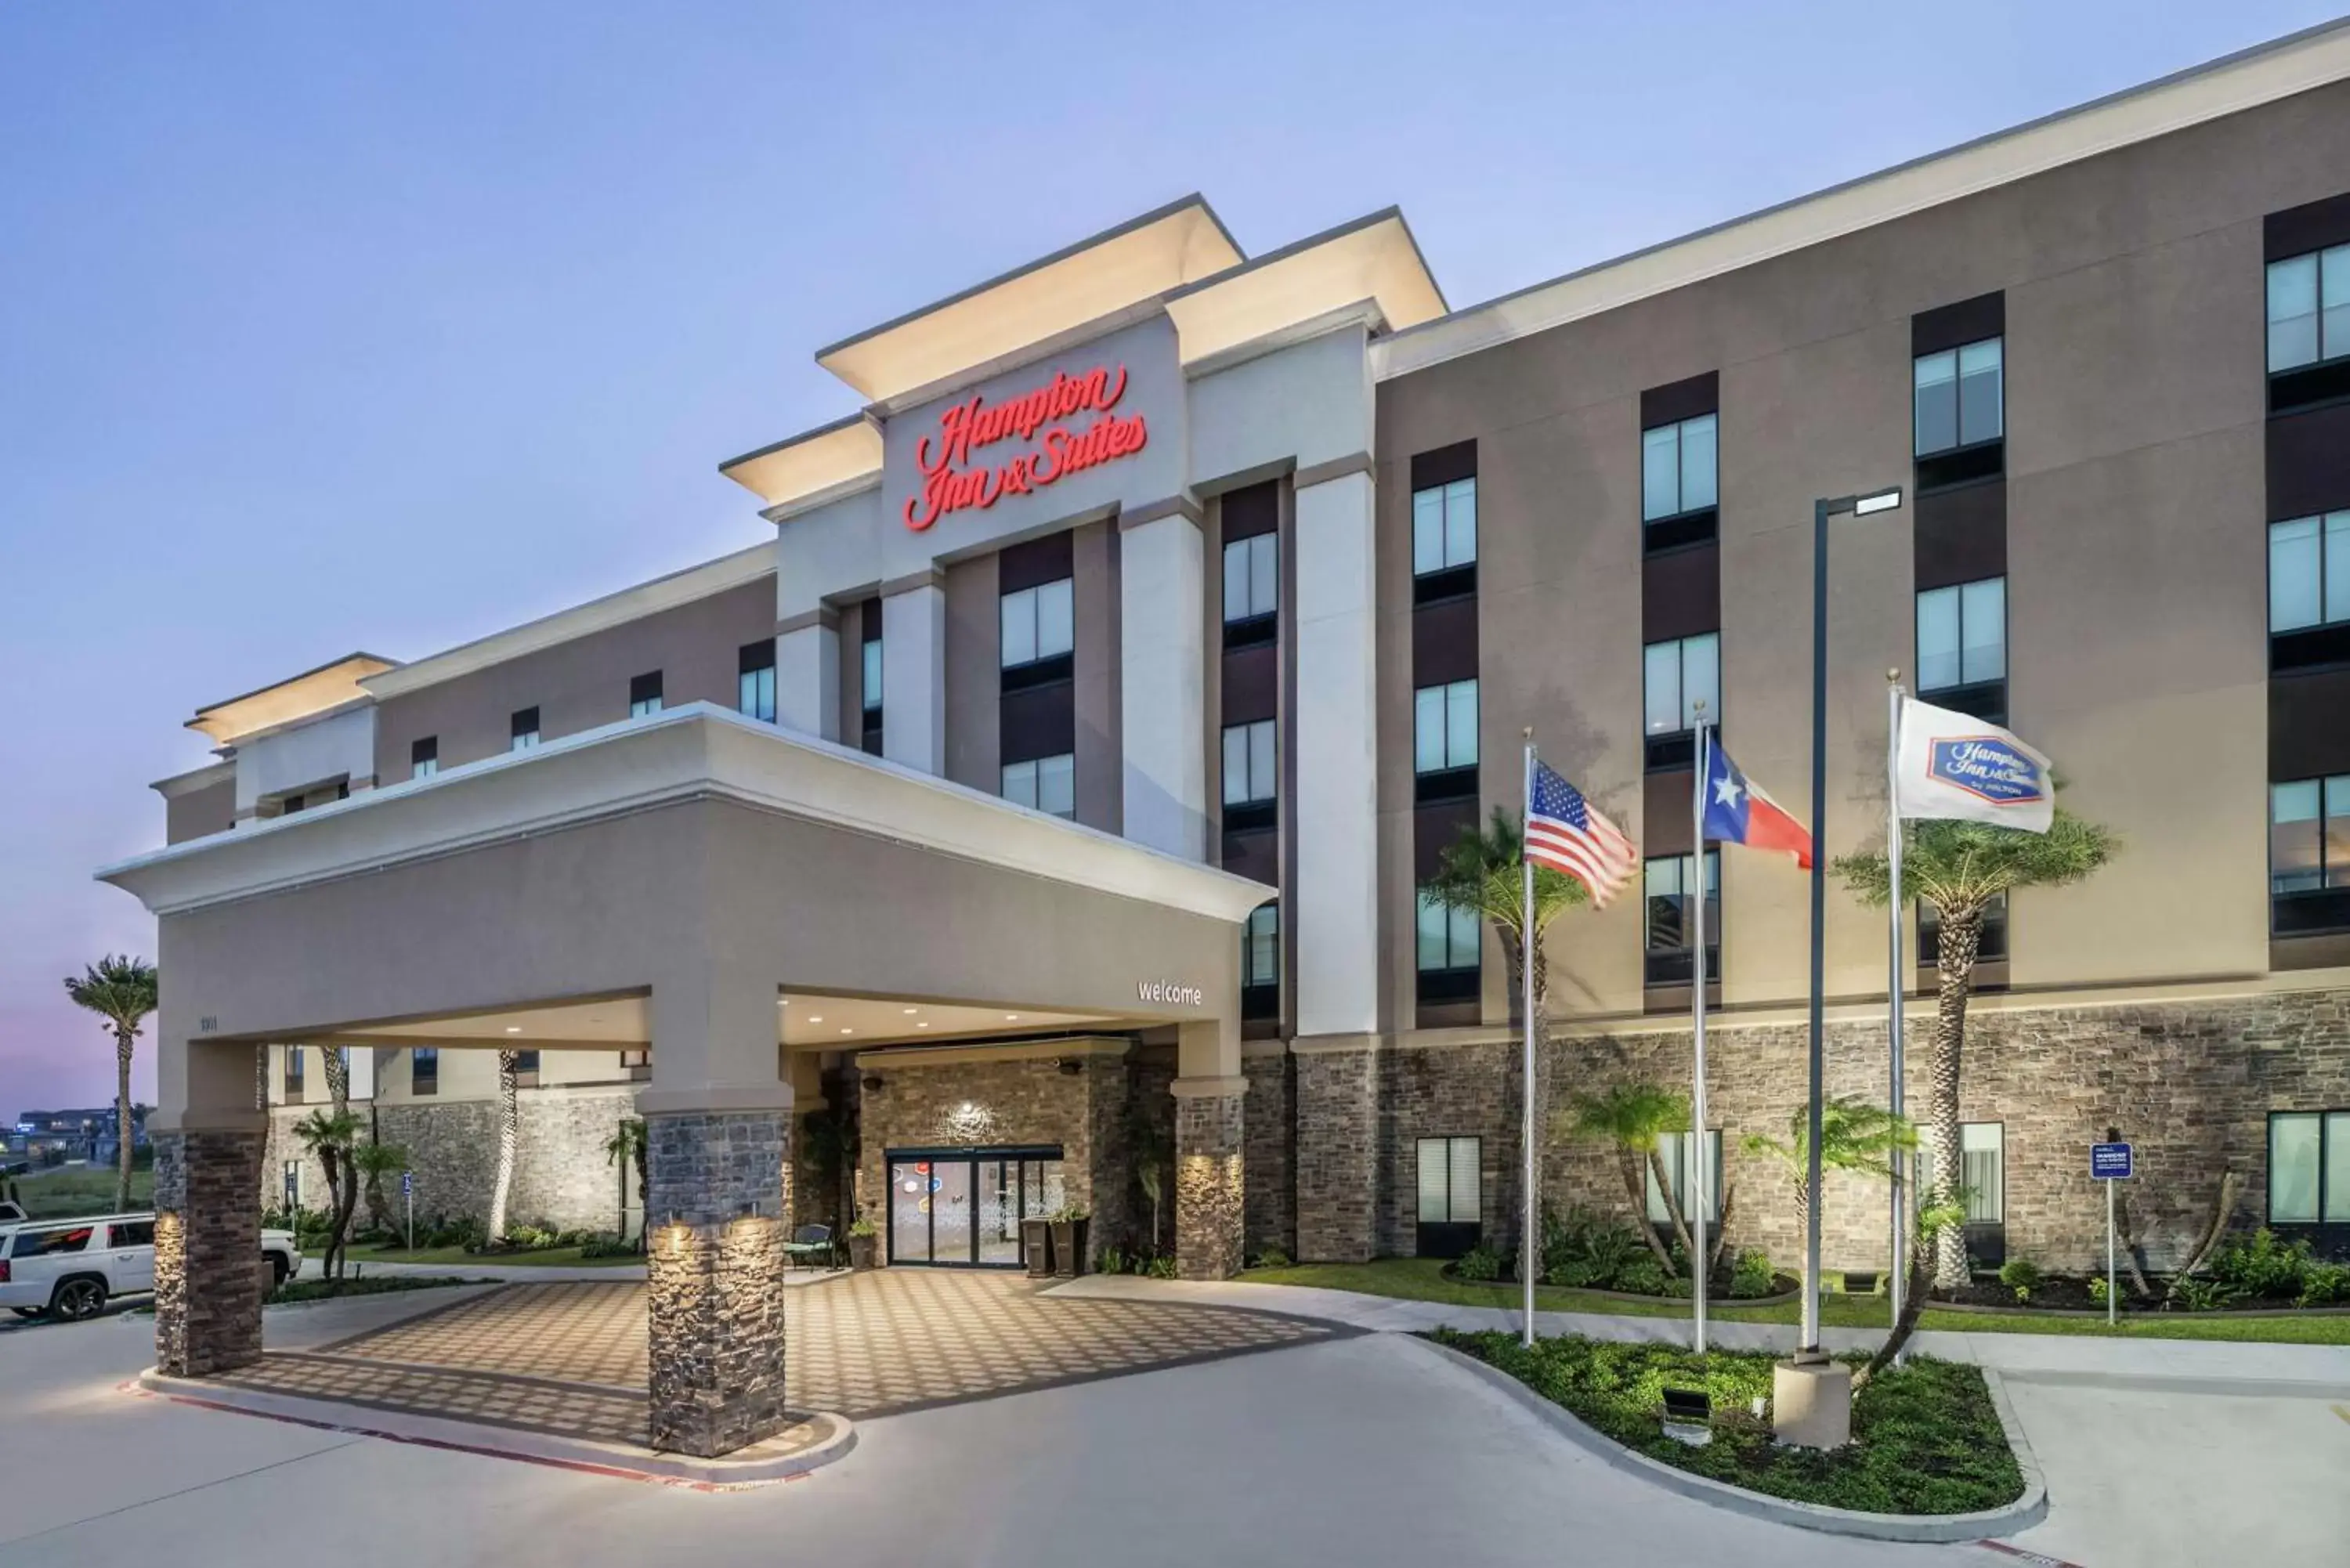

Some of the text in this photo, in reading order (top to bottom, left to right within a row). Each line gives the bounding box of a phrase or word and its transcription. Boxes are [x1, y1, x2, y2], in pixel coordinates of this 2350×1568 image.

[904, 410, 1148, 533] Inn & Suites
[917, 360, 1128, 477] Hampton
[1137, 979, 1202, 1006] welcome
